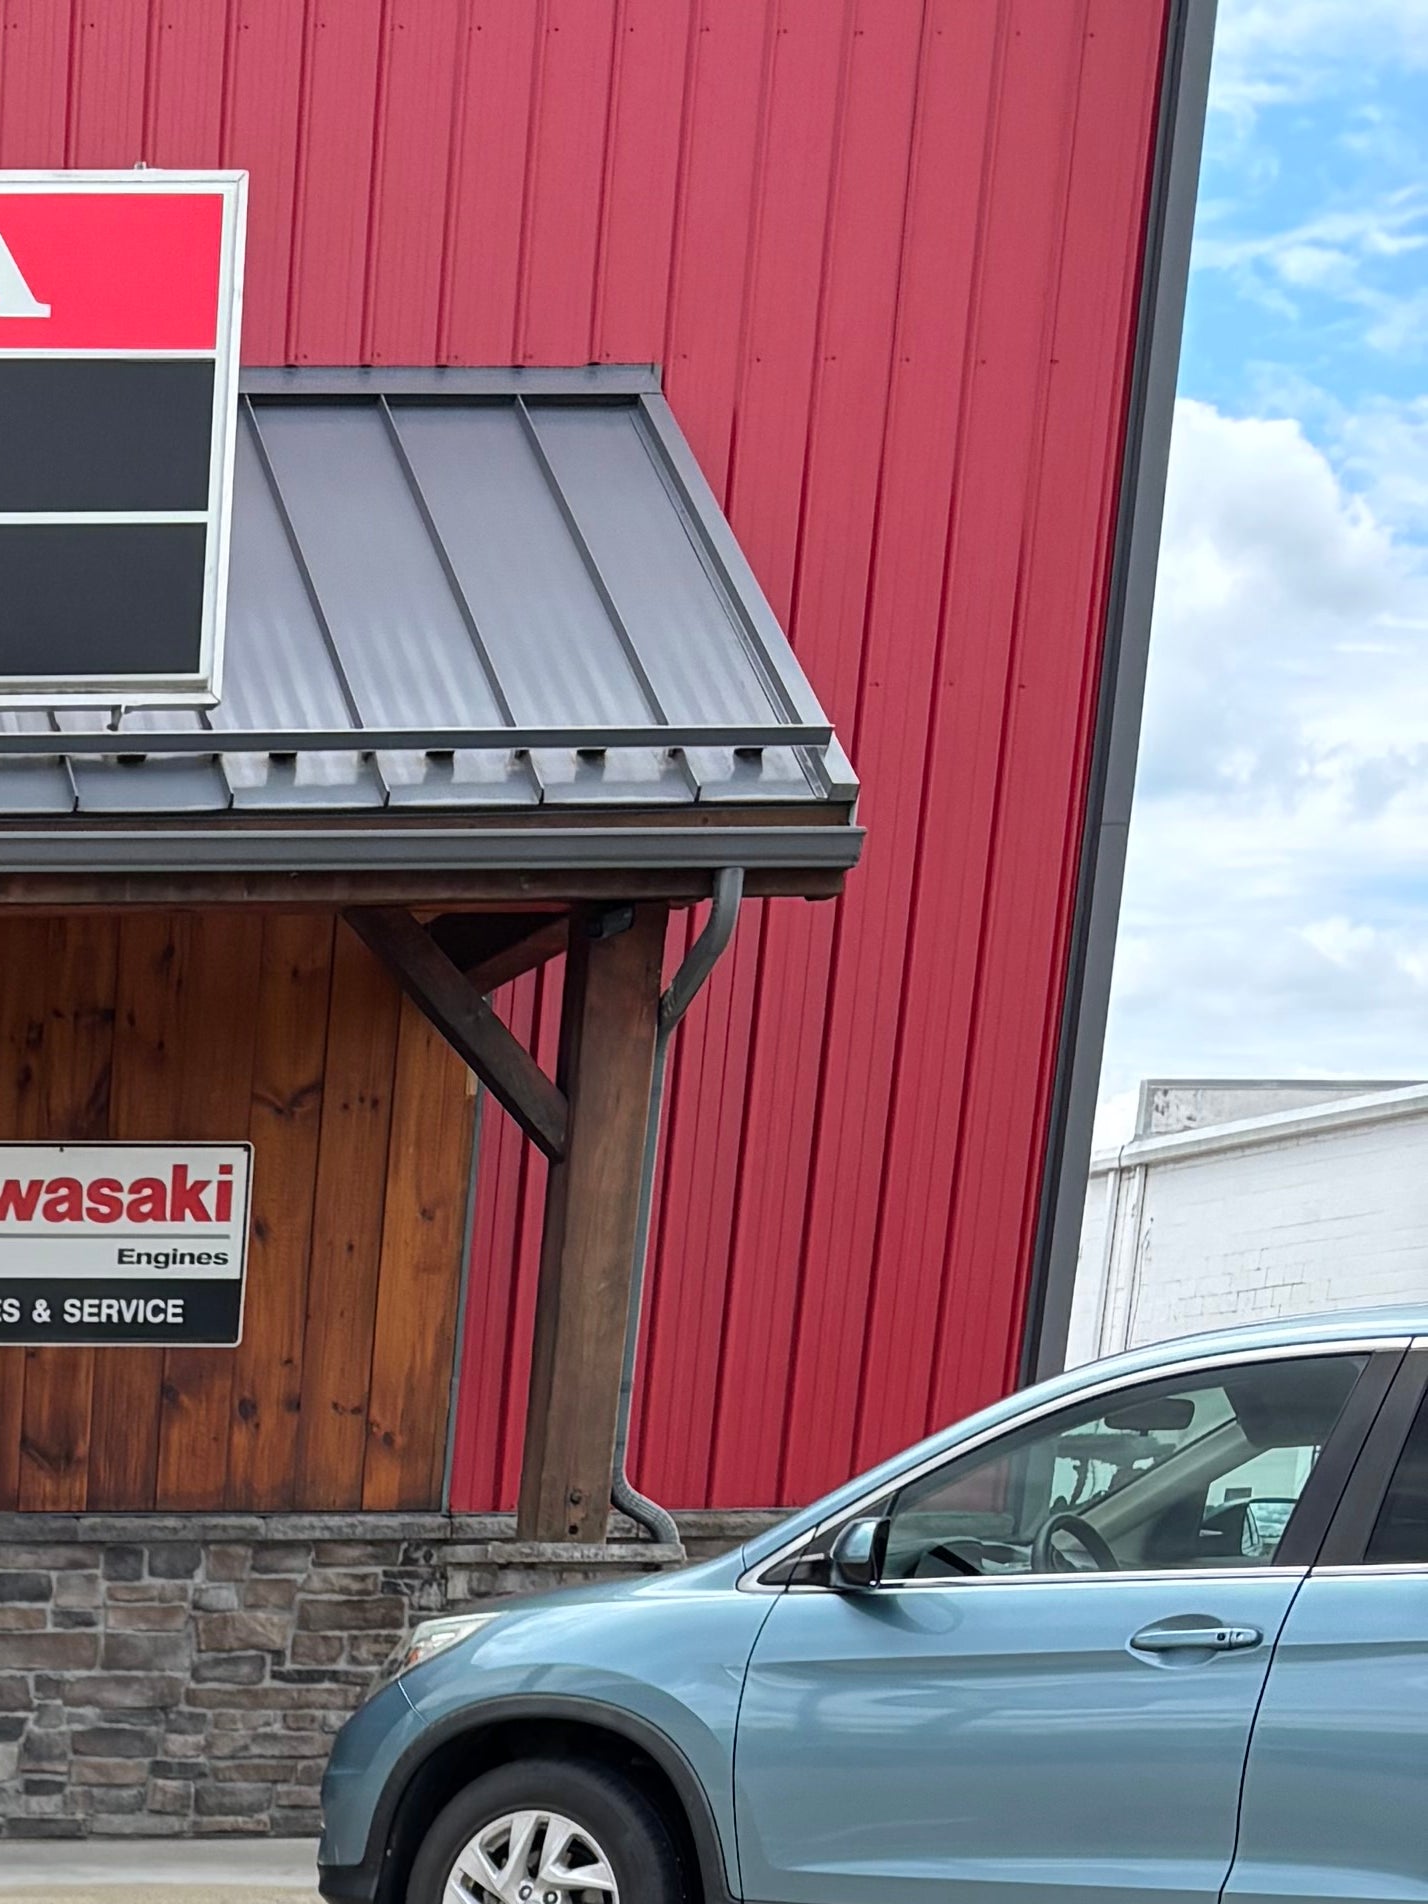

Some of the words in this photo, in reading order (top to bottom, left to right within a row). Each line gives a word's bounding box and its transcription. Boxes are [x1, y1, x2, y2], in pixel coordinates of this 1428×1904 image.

[116, 1247, 230, 1270] Engines
[31, 1298, 52, 1324] &
[62, 1298, 185, 1324] SERVICE
